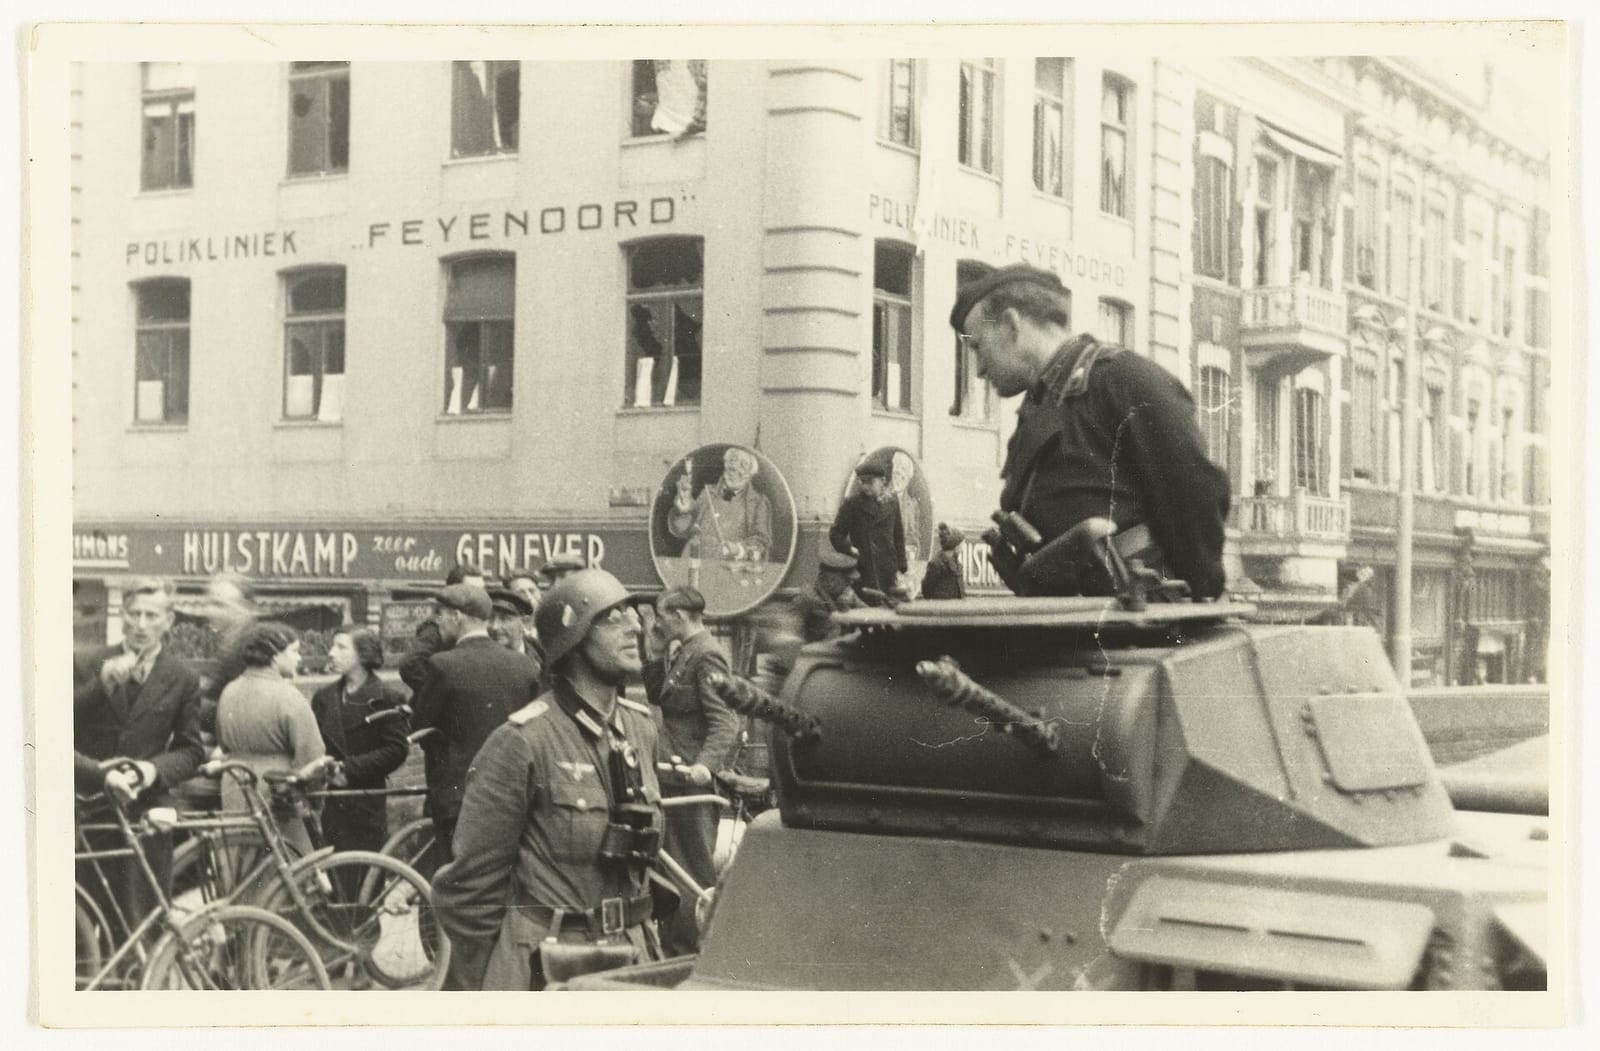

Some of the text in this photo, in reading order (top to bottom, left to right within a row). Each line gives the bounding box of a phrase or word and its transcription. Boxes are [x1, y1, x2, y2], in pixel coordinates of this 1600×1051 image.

[869, 193, 979, 249] POLIINIEK
[126, 230, 297, 265] POLIKLINIEK
[73, 535, 128, 558] IMONS
[183, 531, 358, 574] HULSTKAMP
[373, 535, 417, 552] zeer
[395, 549, 443, 572] oude
